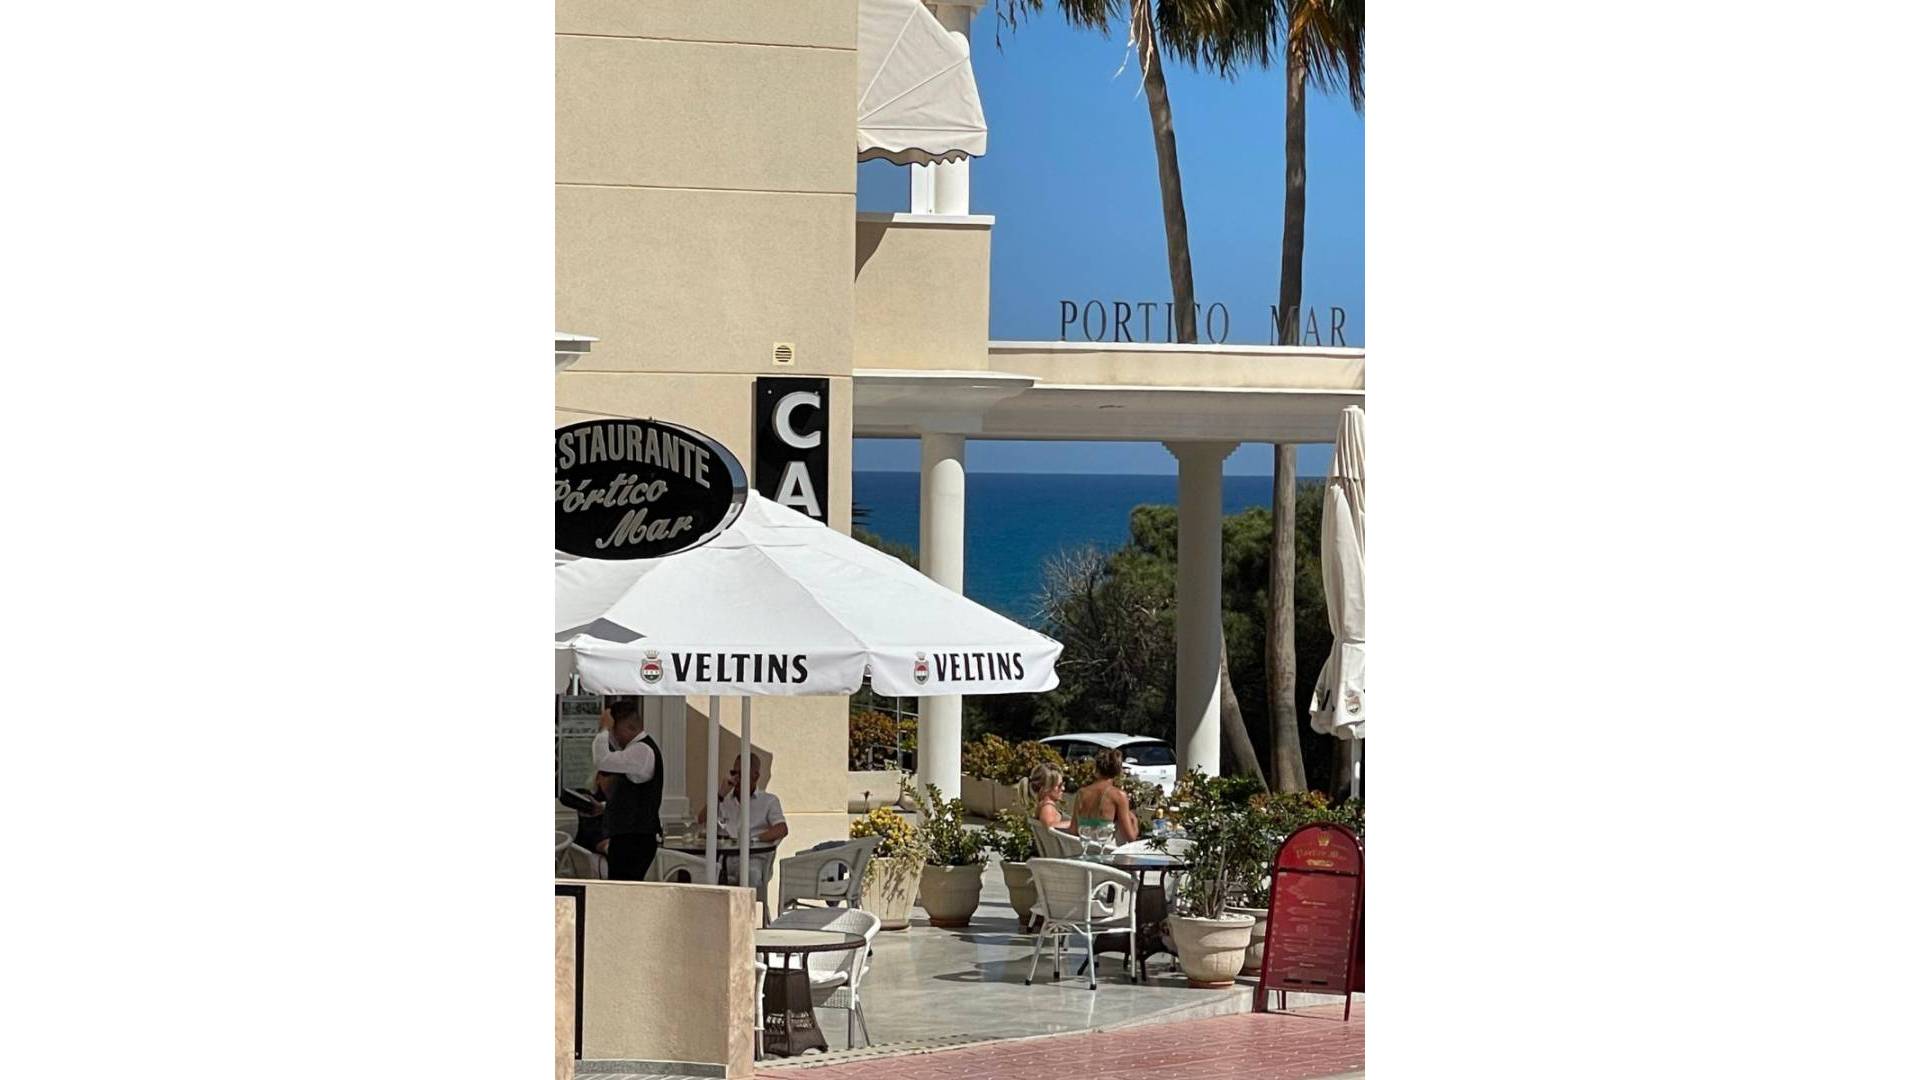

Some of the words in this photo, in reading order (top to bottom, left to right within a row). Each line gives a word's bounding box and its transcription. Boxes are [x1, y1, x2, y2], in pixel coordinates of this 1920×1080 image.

[1060, 300, 1229, 344] PORTIO
[1269, 305, 1346, 347] MAR
[555, 424, 711, 489] STAURANTE
[595, 507, 693, 549] Mar
[671, 652, 809, 684] VELTINS
[933, 652, 1025, 681] VELTINS
